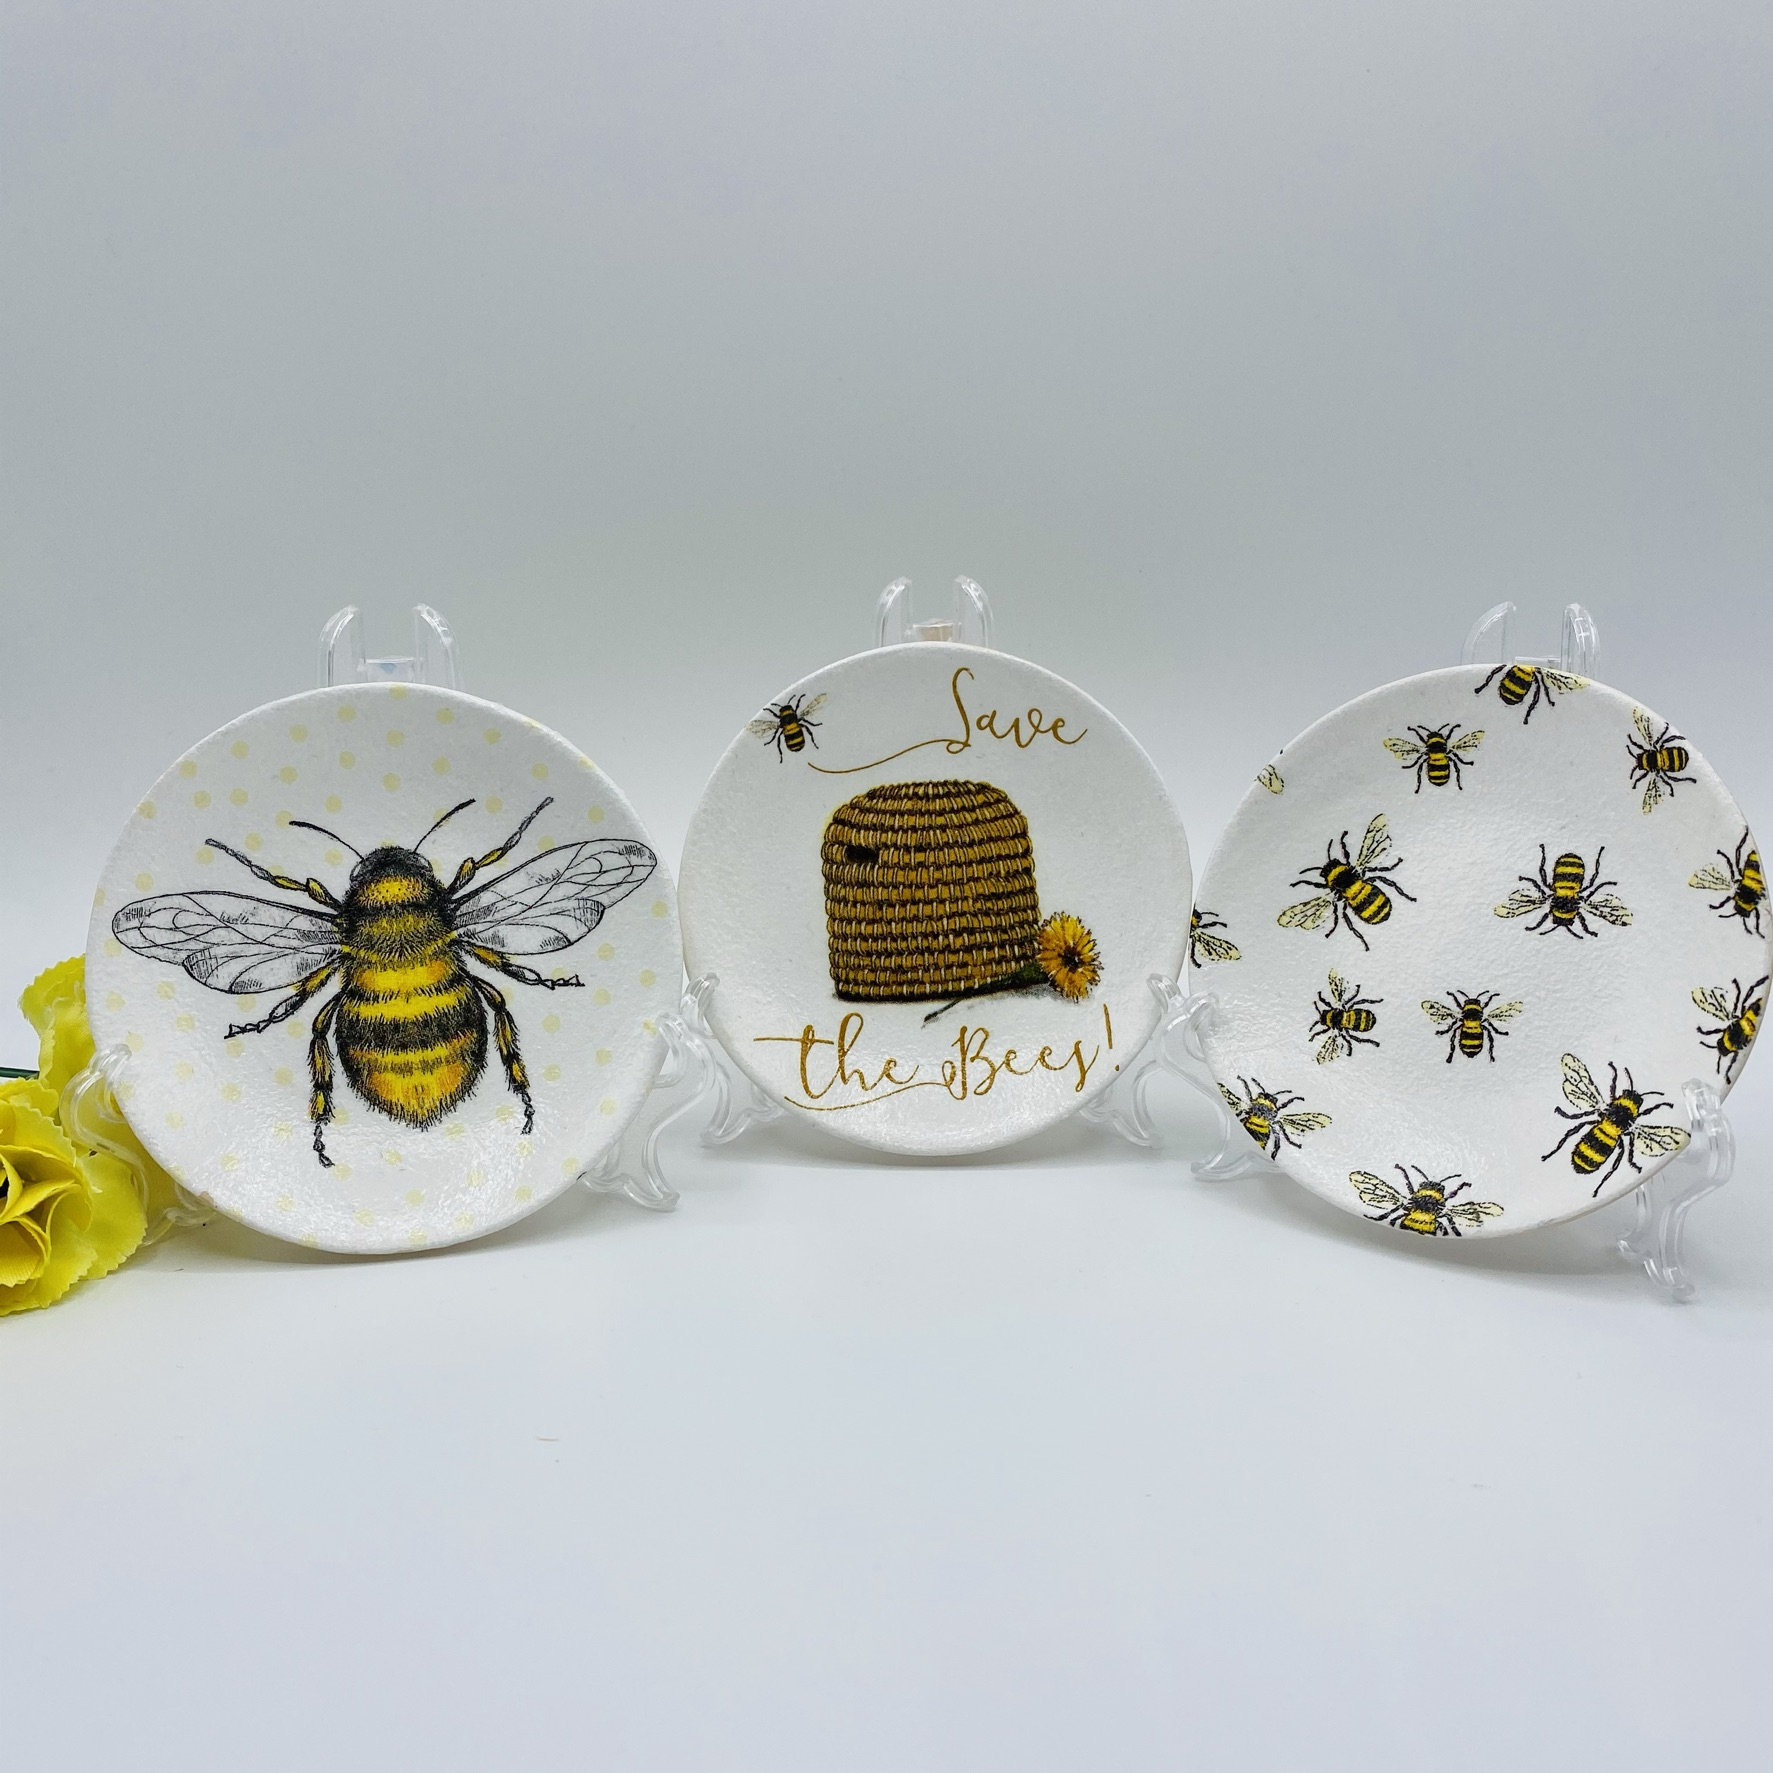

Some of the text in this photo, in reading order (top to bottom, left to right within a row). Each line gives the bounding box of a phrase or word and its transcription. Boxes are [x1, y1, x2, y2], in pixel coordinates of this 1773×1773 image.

[945, 667, 1089, 754] Save
[753, 1003, 1121, 1101] the Bees!
